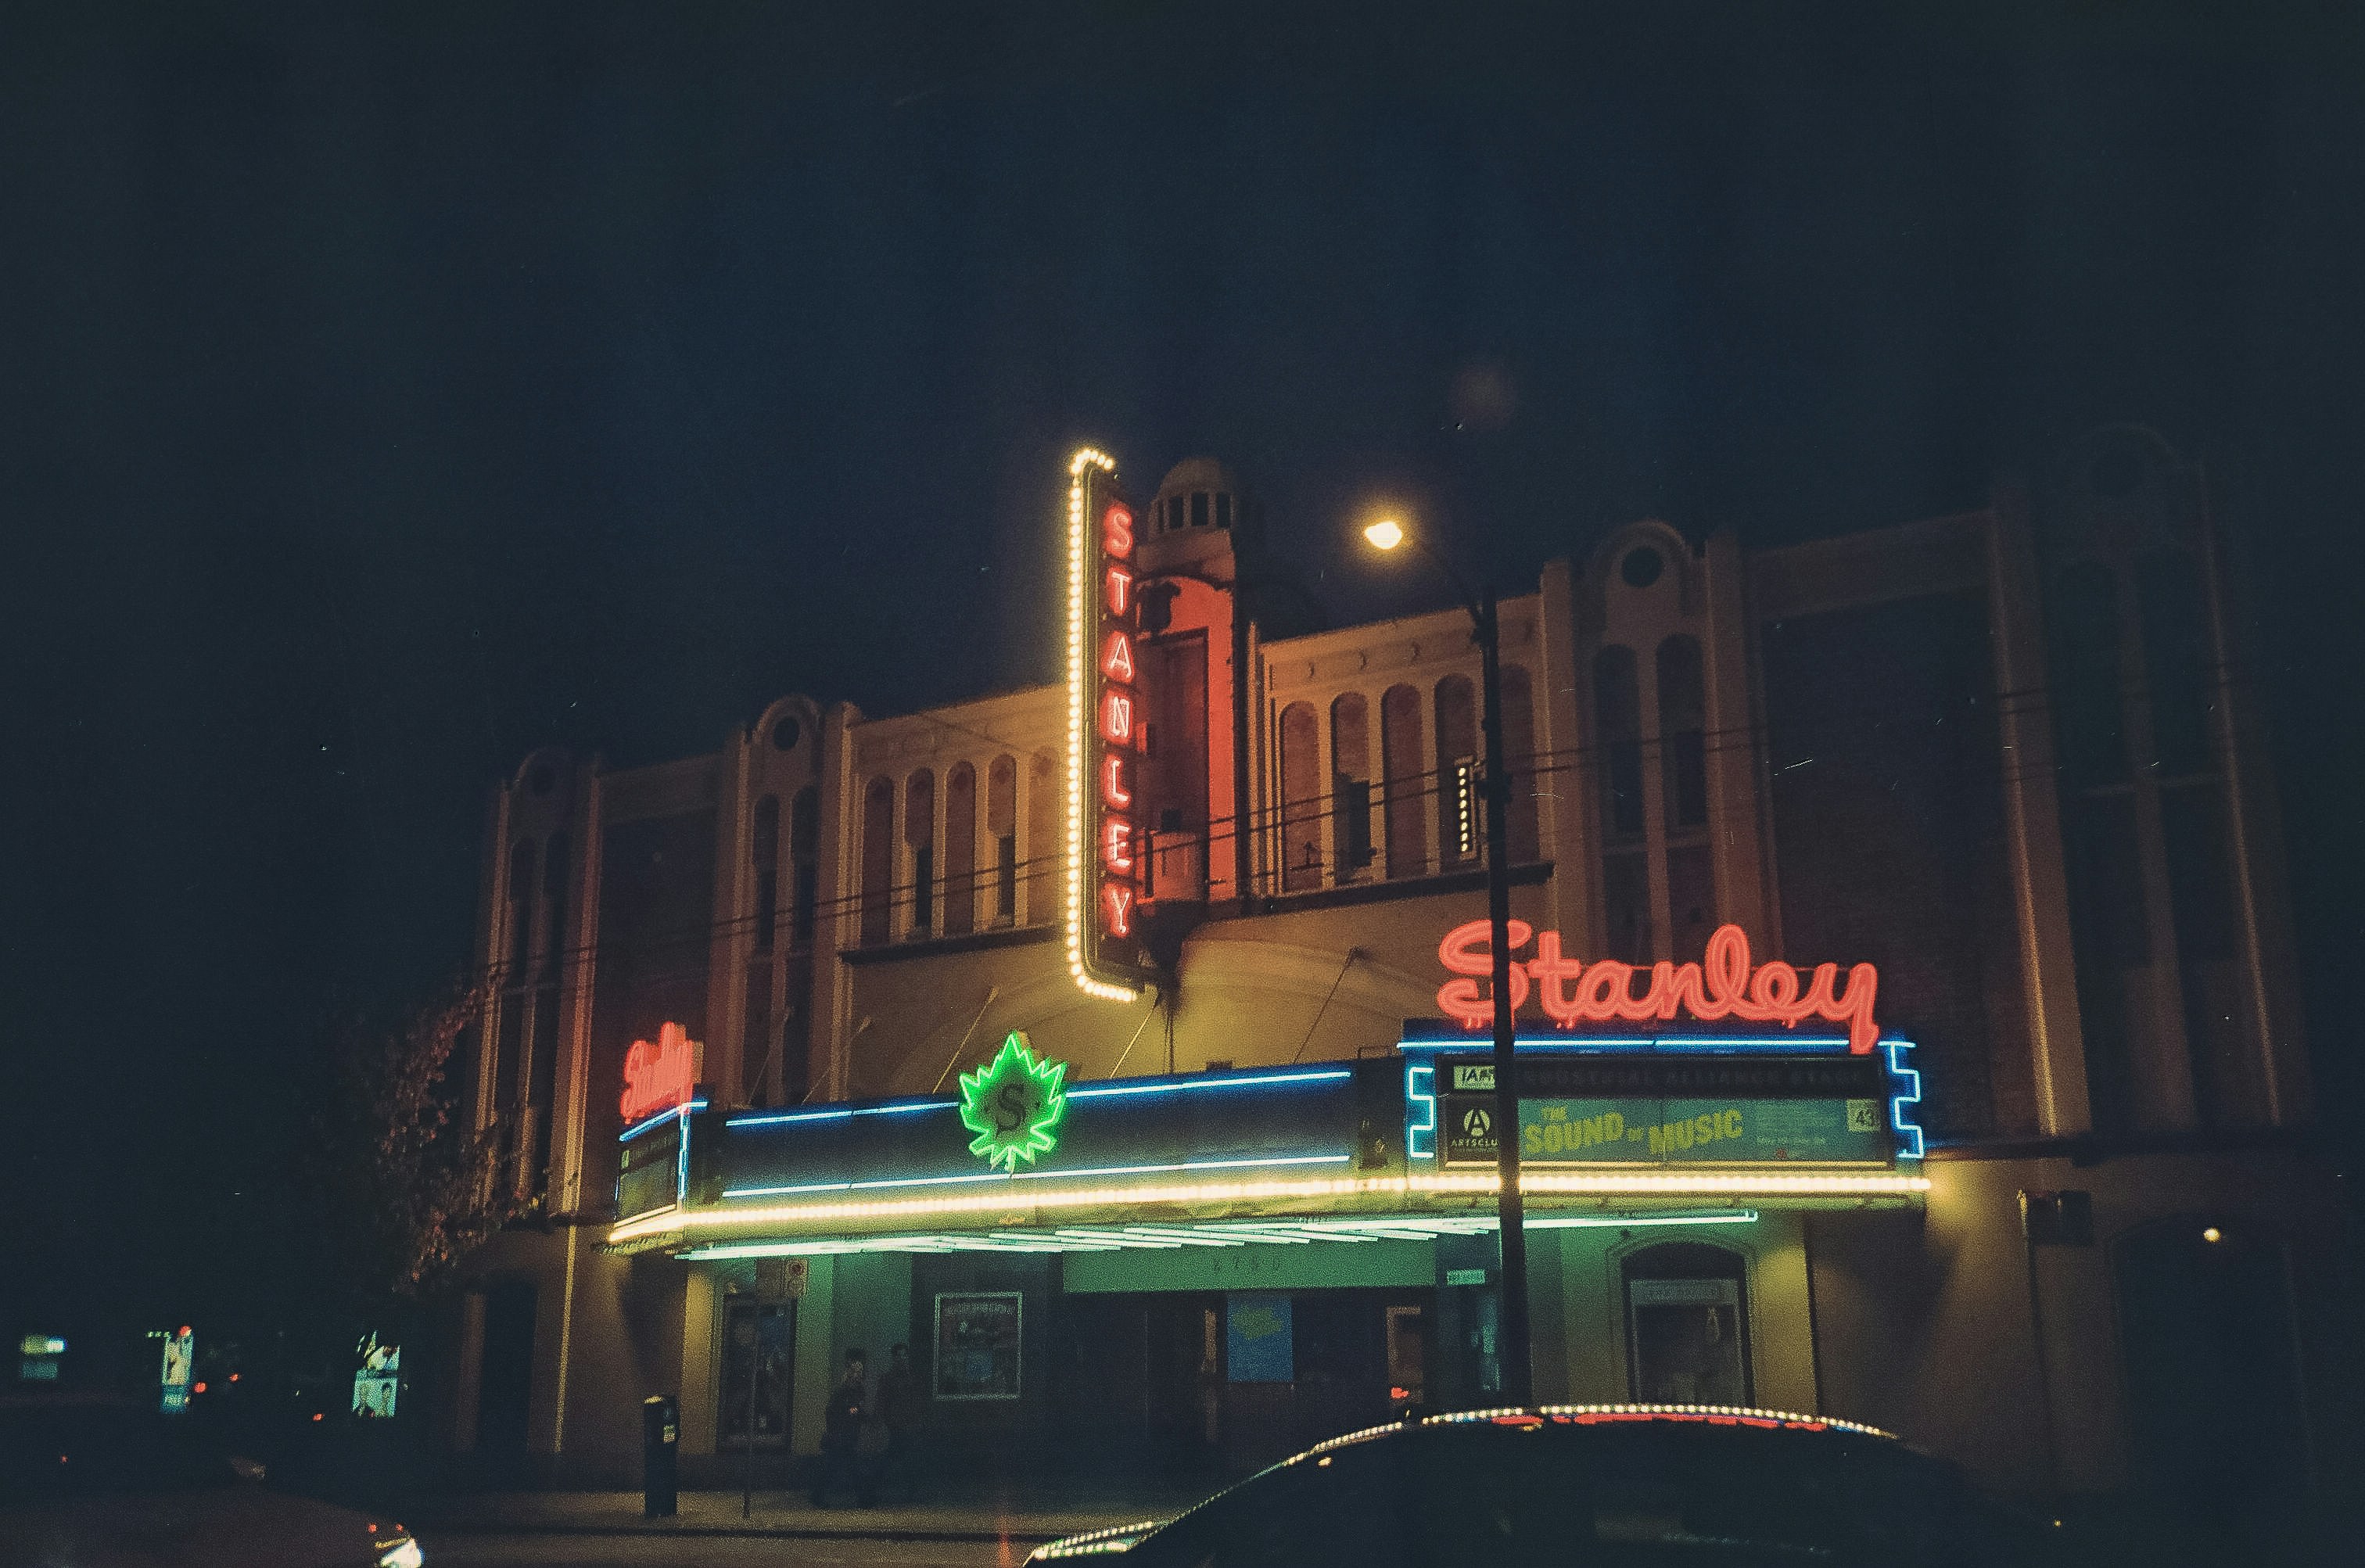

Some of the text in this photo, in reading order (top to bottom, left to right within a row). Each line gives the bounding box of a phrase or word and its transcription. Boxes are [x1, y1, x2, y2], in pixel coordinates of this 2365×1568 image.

[1104, 504, 1134, 935] STANLEY
[1437, 918, 1879, 1054] Stanley
[1523, 1070, 1654, 1086] NDUSTRIAL
[996, 1083, 1026, 1131] S
[1541, 1107, 1566, 1121] THE
[1452, 1139, 1498, 1147] ARTSCLU
[1524, 1111, 1624, 1154] SOUND
[1649, 1109, 1742, 1154] MUSIC
